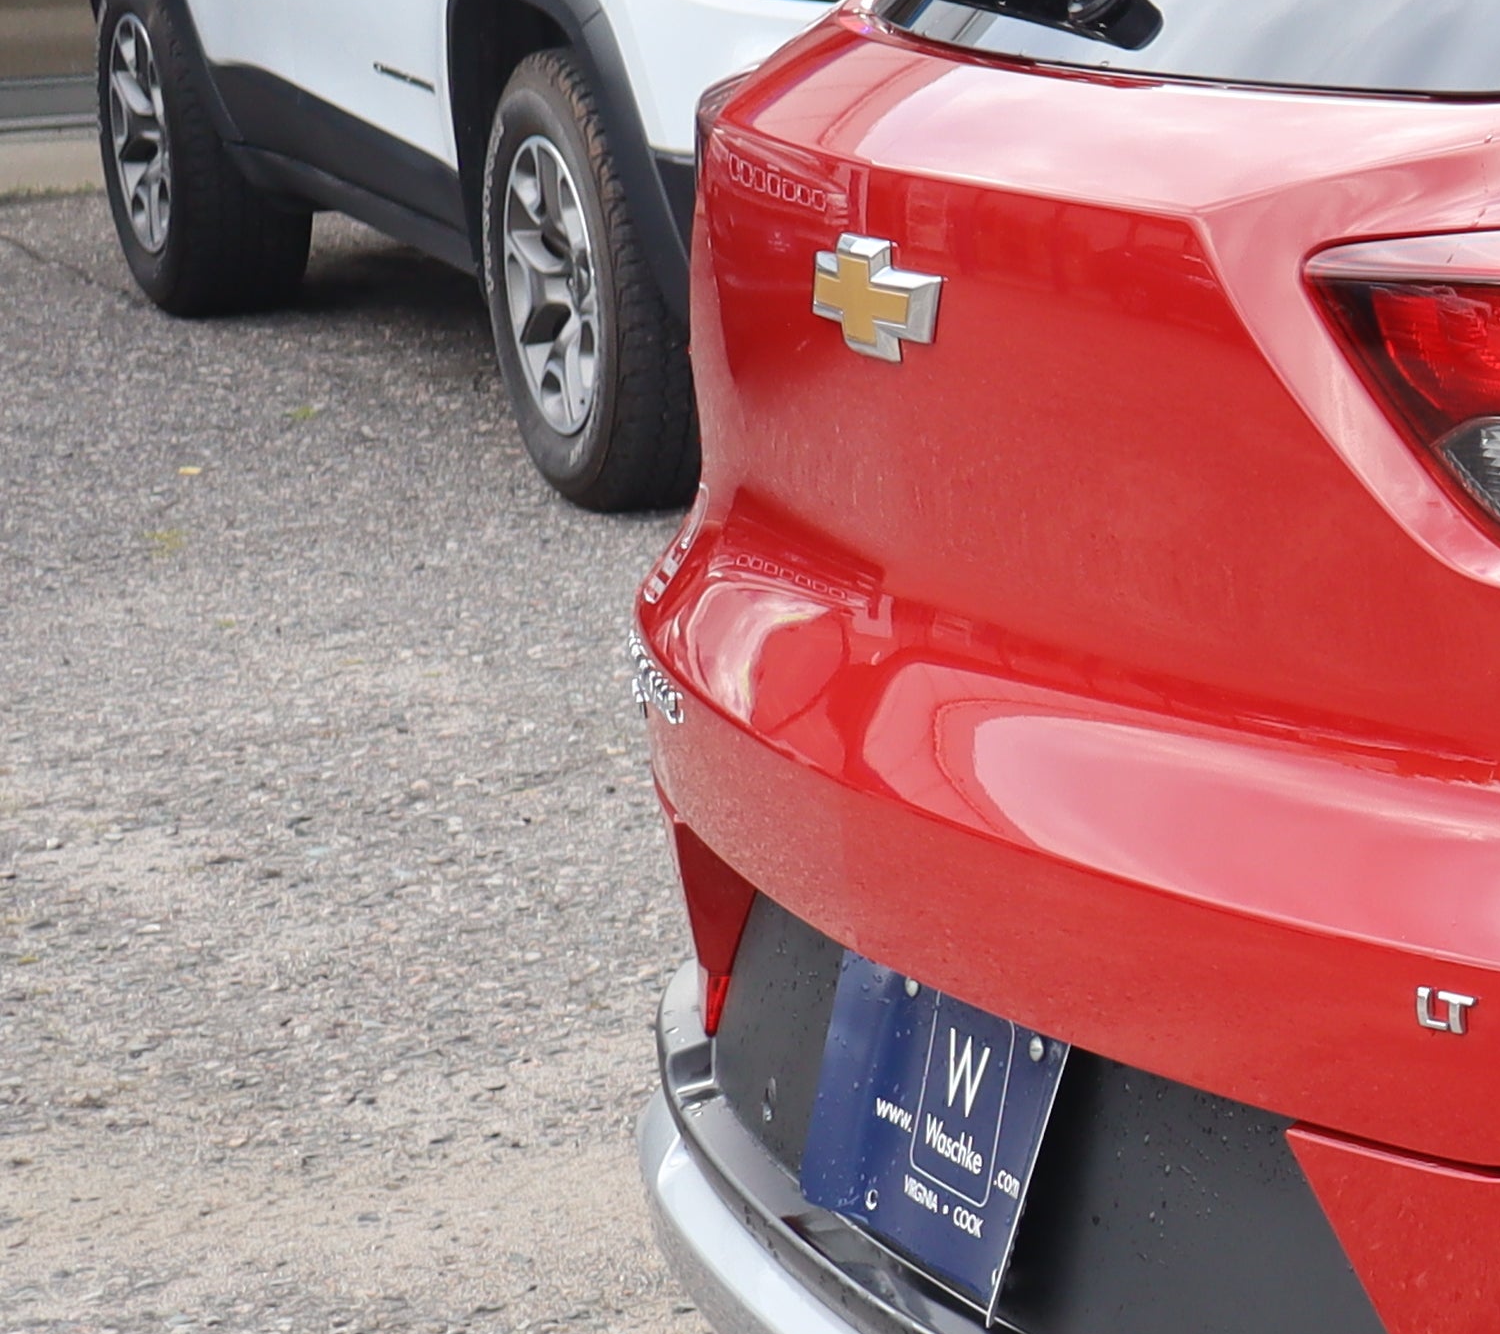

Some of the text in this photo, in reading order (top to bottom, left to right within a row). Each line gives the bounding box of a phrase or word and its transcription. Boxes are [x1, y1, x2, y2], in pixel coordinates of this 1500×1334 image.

[1416, 986, 1477, 1035] LT
[946, 1027, 991, 1118] W
[875, 1097, 1021, 1200] www. Waschke .com
[904, 1174, 985, 1239] VIRGINIA COOK
